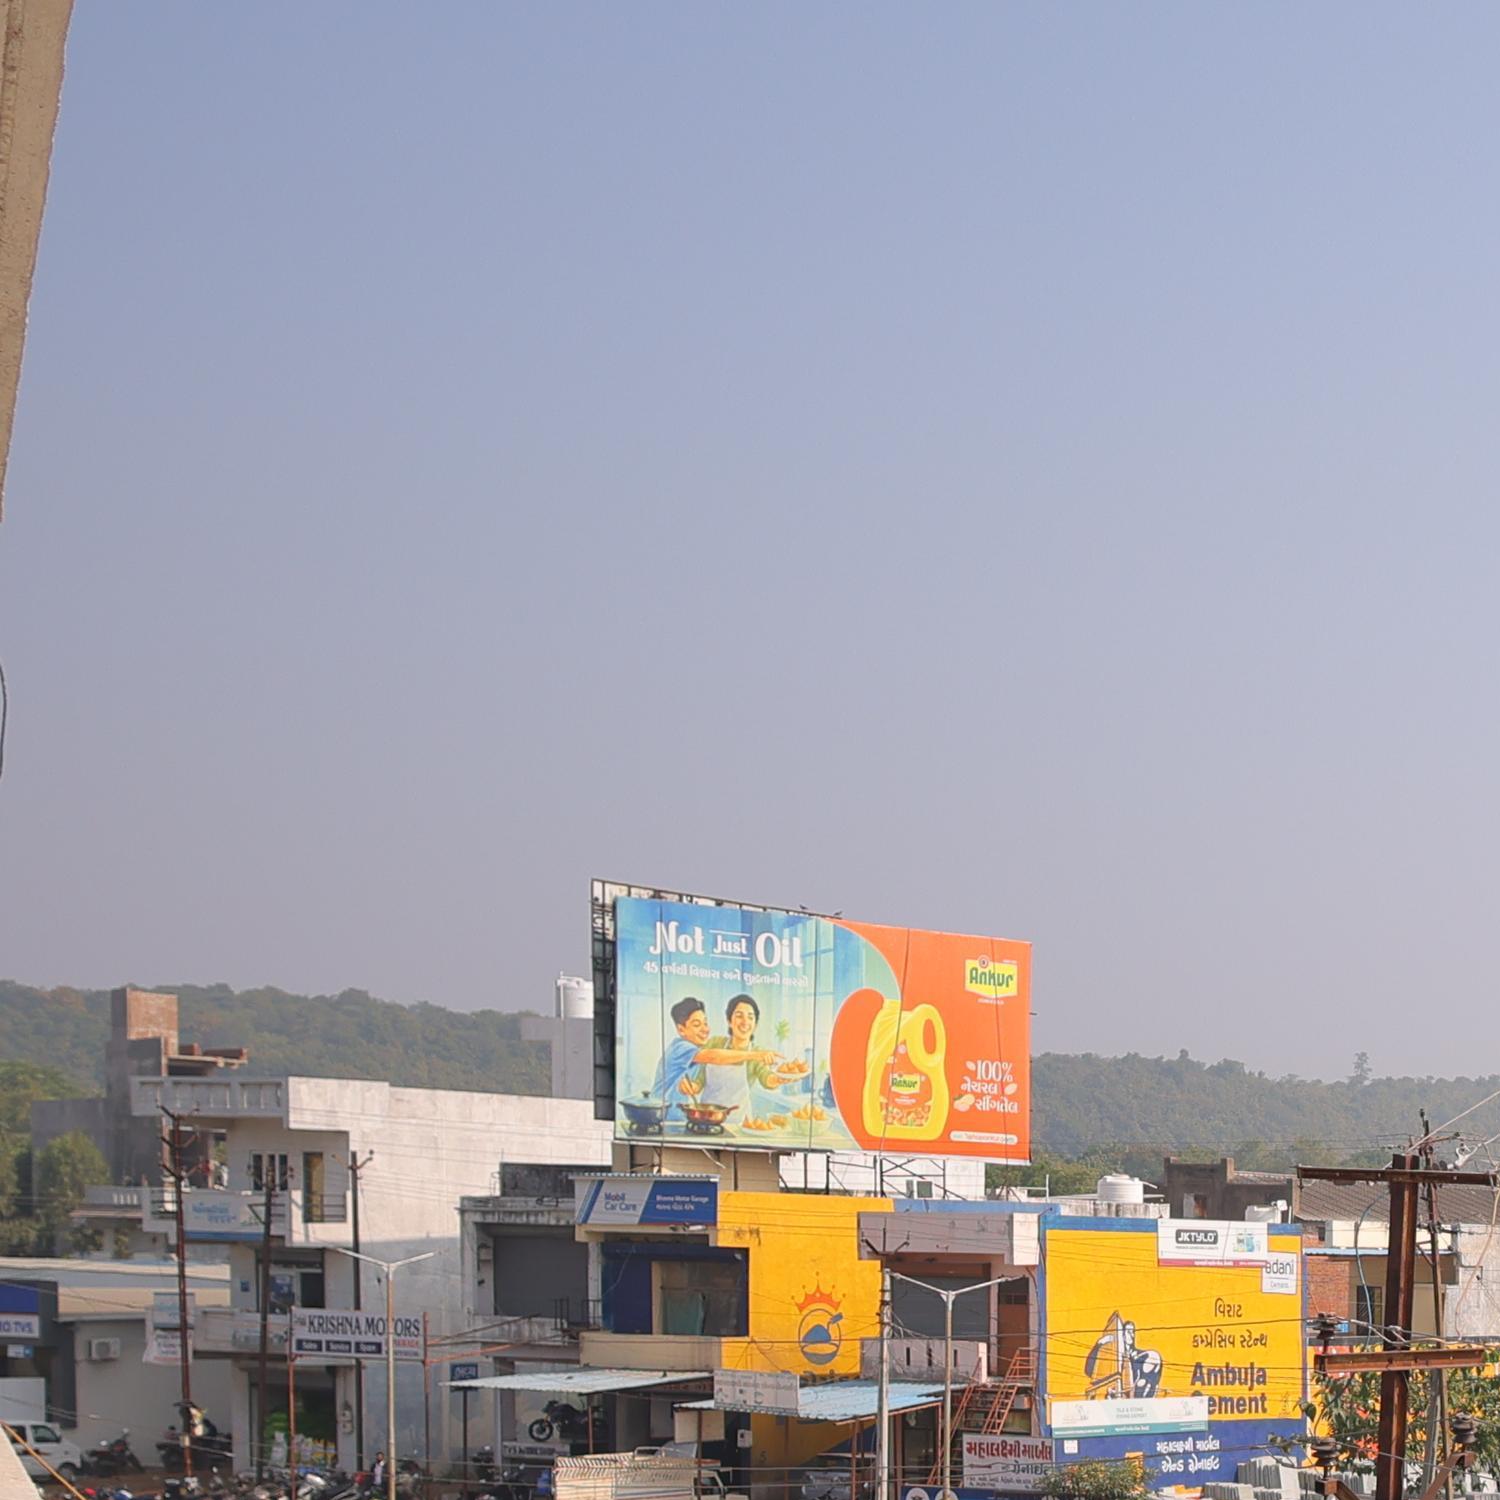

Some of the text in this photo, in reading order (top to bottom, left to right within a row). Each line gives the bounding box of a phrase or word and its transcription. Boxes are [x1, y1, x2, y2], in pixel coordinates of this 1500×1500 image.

[649, 921, 804, 968] Not Just Oil
[643, 961, 659, 974] 45
[969, 966, 1014, 988] Ankur
[976, 1060, 1013, 1082] 100%
[604, 1192, 626, 1202] Mobil
[604, 1201, 637, 1212] Car Care
[1265, 1259, 1294, 1275] adani
[1214, 1298, 1243, 1318] વિરાટ
[308, 1315, 362, 1335] KRISHNA
[364, 1318, 420, 1337] MOORS
[1191, 1362, 1267, 1391] Ambuja
[1192, 1390, 1267, 1415] ement
[966, 1440, 1020, 1459] મહાલક્ષ્મી
